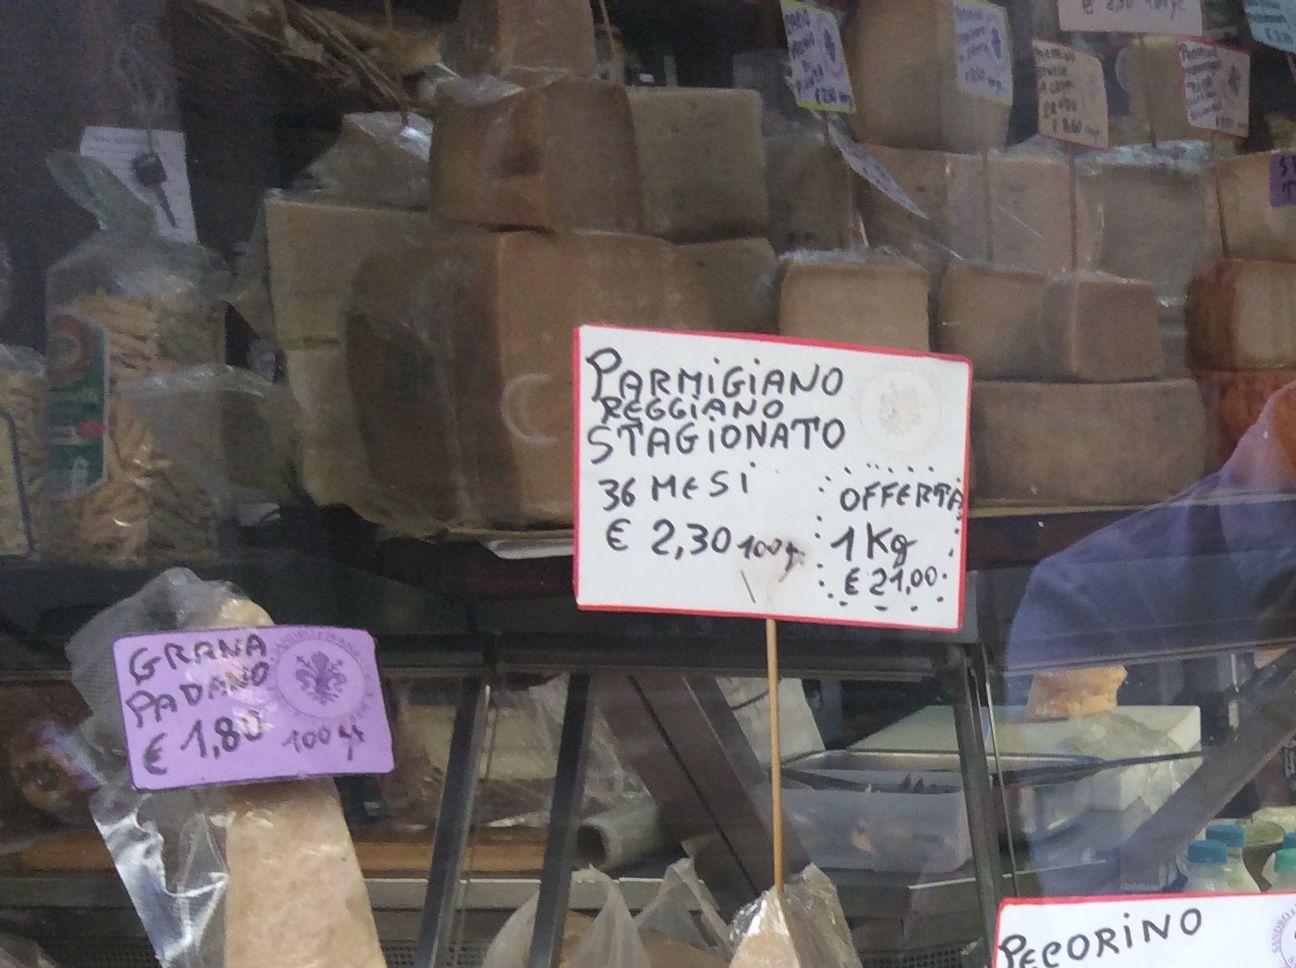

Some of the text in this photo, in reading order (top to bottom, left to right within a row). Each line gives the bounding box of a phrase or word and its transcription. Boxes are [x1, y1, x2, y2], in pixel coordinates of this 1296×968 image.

[586, 348, 843, 400] PARMIGIANO
[601, 396, 784, 423] REGGIANO
[587, 417, 846, 464] STAGIONATO
[599, 462, 756, 511] 36 MESI
[840, 482, 963, 512] OFFERTA
[606, 518, 630, 551] €
[651, 518, 731, 559] 2,30
[866, 522, 917, 567] Kg
[844, 568, 859, 595] €
[129, 634, 267, 686] GRANA
[126, 661, 270, 728] PADANO
[143, 733, 167, 775] €
[180, 710, 262, 759] 1,80
